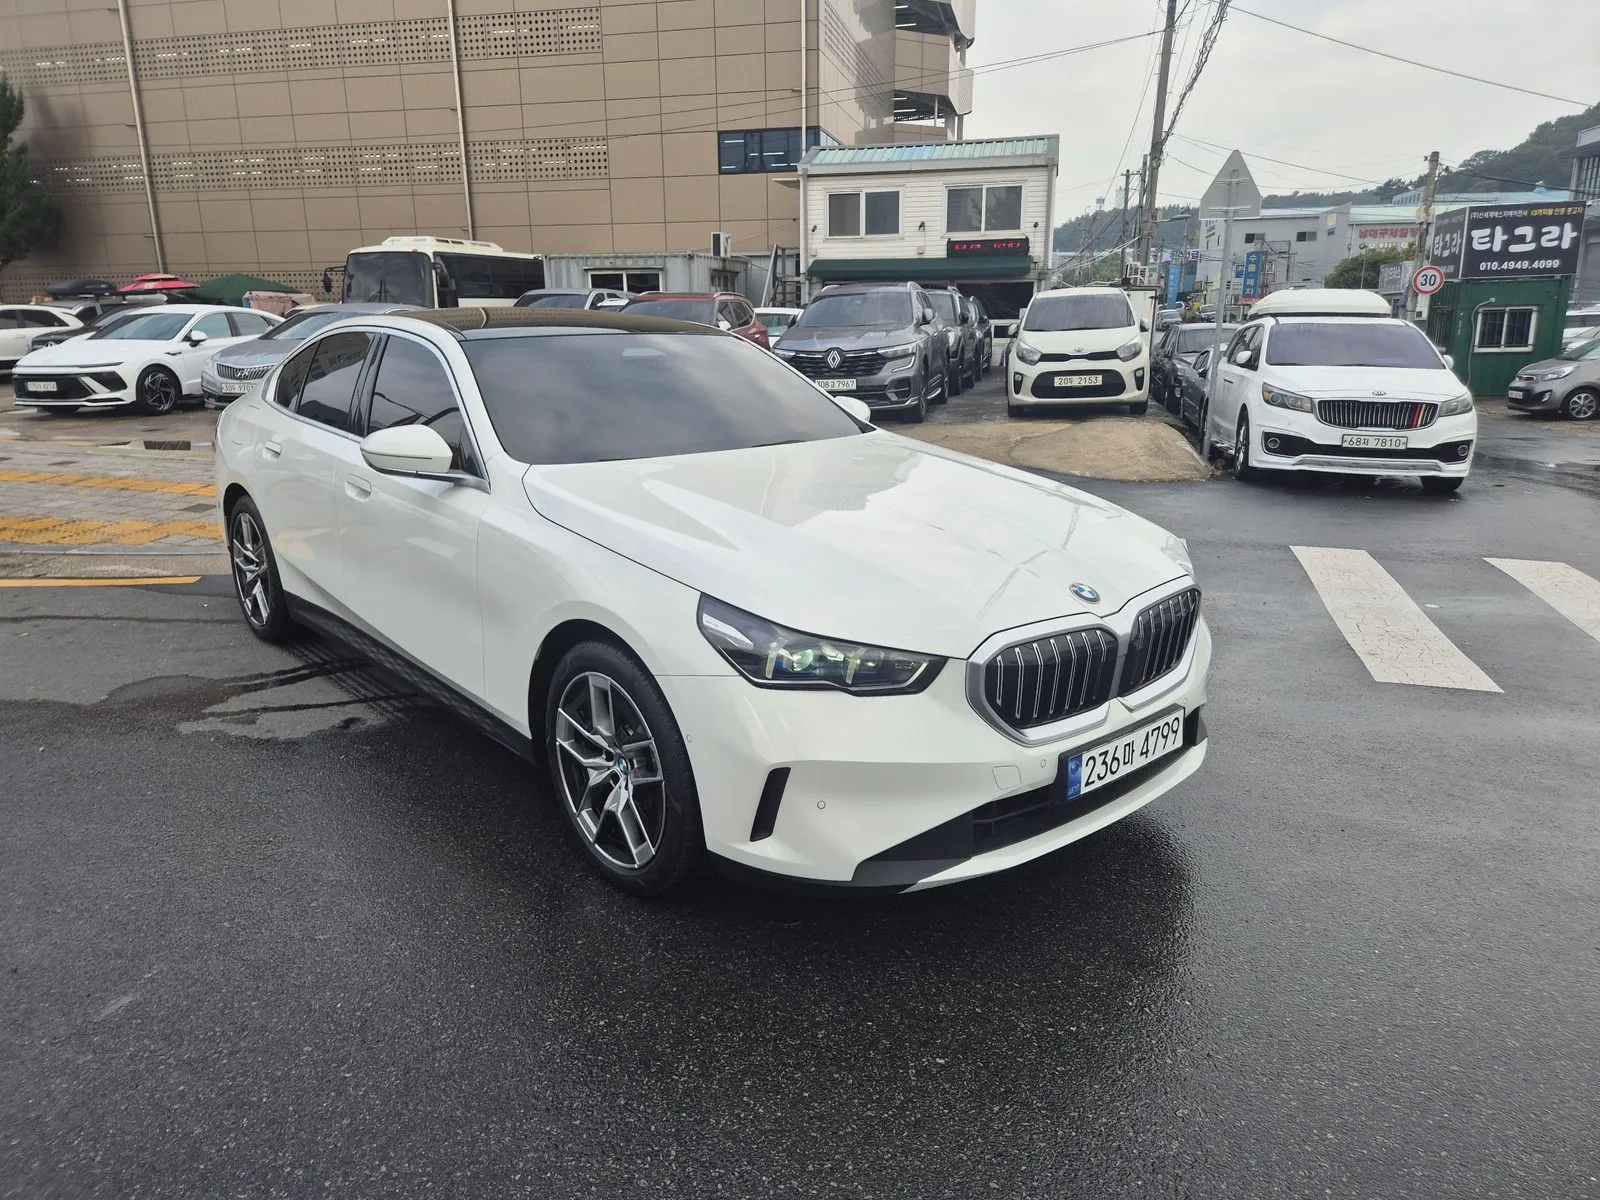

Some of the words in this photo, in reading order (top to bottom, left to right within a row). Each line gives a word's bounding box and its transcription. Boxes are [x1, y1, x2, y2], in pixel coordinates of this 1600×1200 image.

[1433, 229, 1461, 257] 타그라
[1470, 222, 1578, 253] 타그라
[1479, 259, 1560, 271] 010.4949.4099
[1420, 274, 1437, 287] 30
[836, 380, 854, 388] 7967
[1077, 376, 1098, 385] 2153
[1374, 437, 1401, 448] 7810
[1084, 740, 1135, 787] 236마
[1140, 717, 1180, 759] 4799
